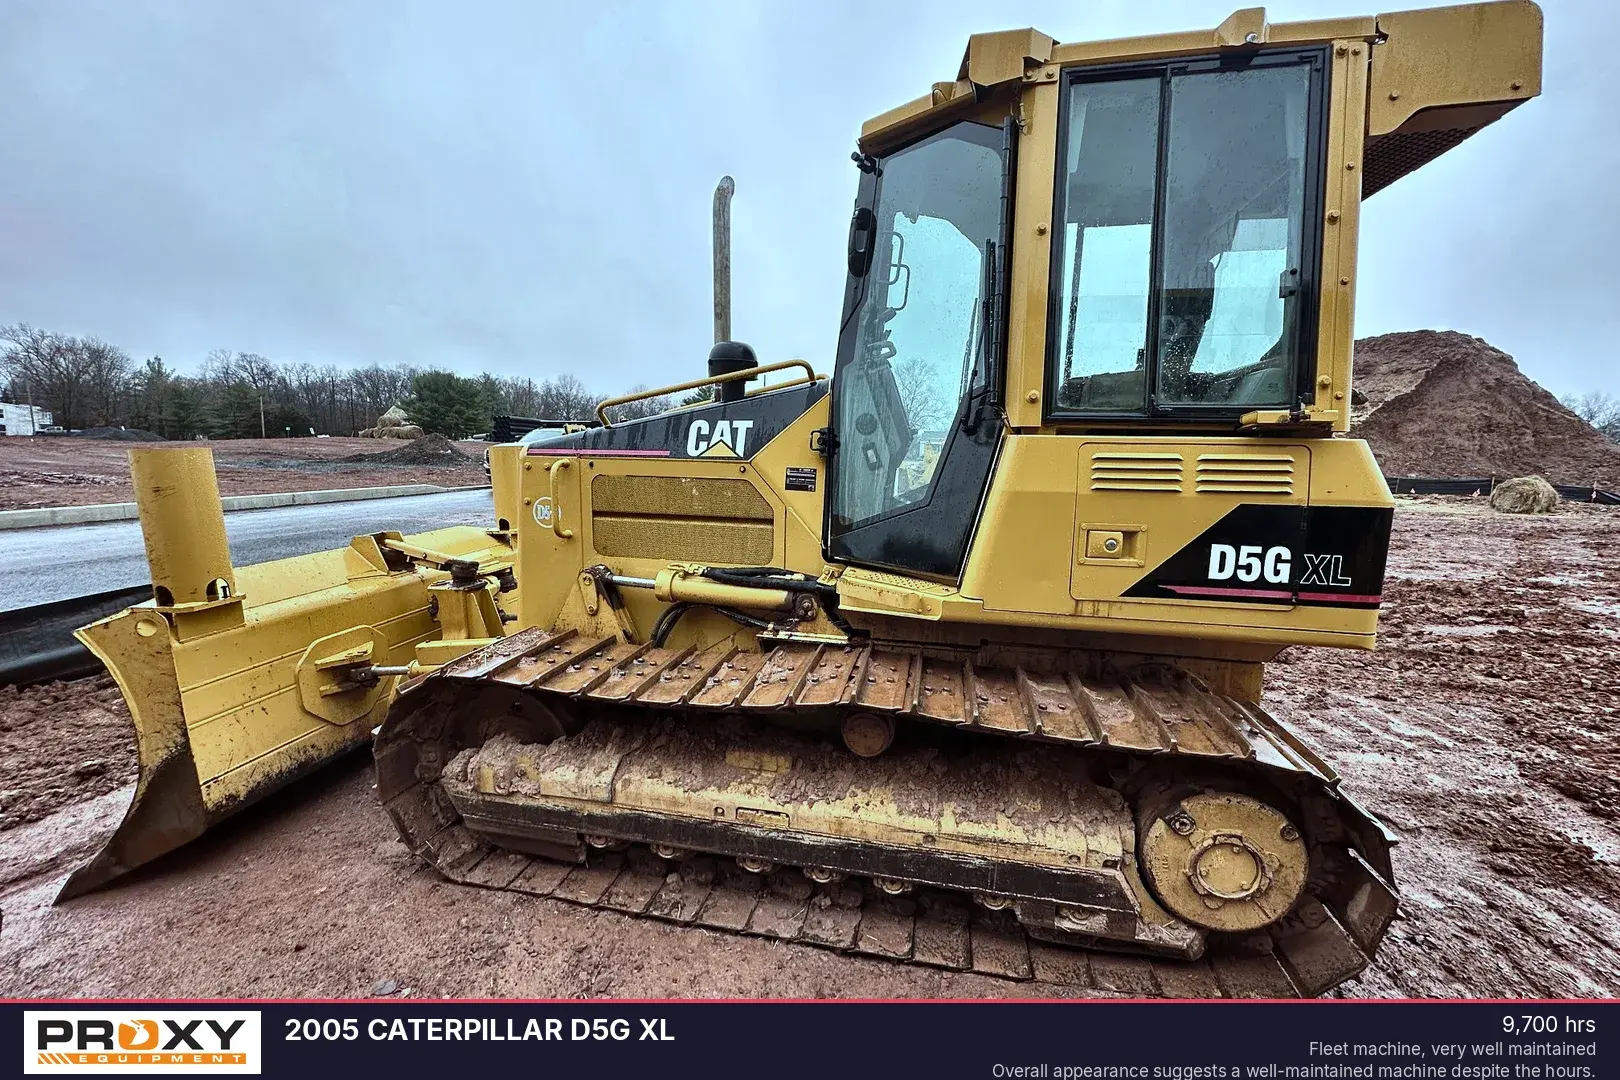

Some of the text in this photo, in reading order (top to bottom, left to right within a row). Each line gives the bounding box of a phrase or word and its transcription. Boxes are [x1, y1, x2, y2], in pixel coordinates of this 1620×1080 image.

[686, 420, 754, 458] CAT
[1208, 543, 1352, 587] D5G XL
